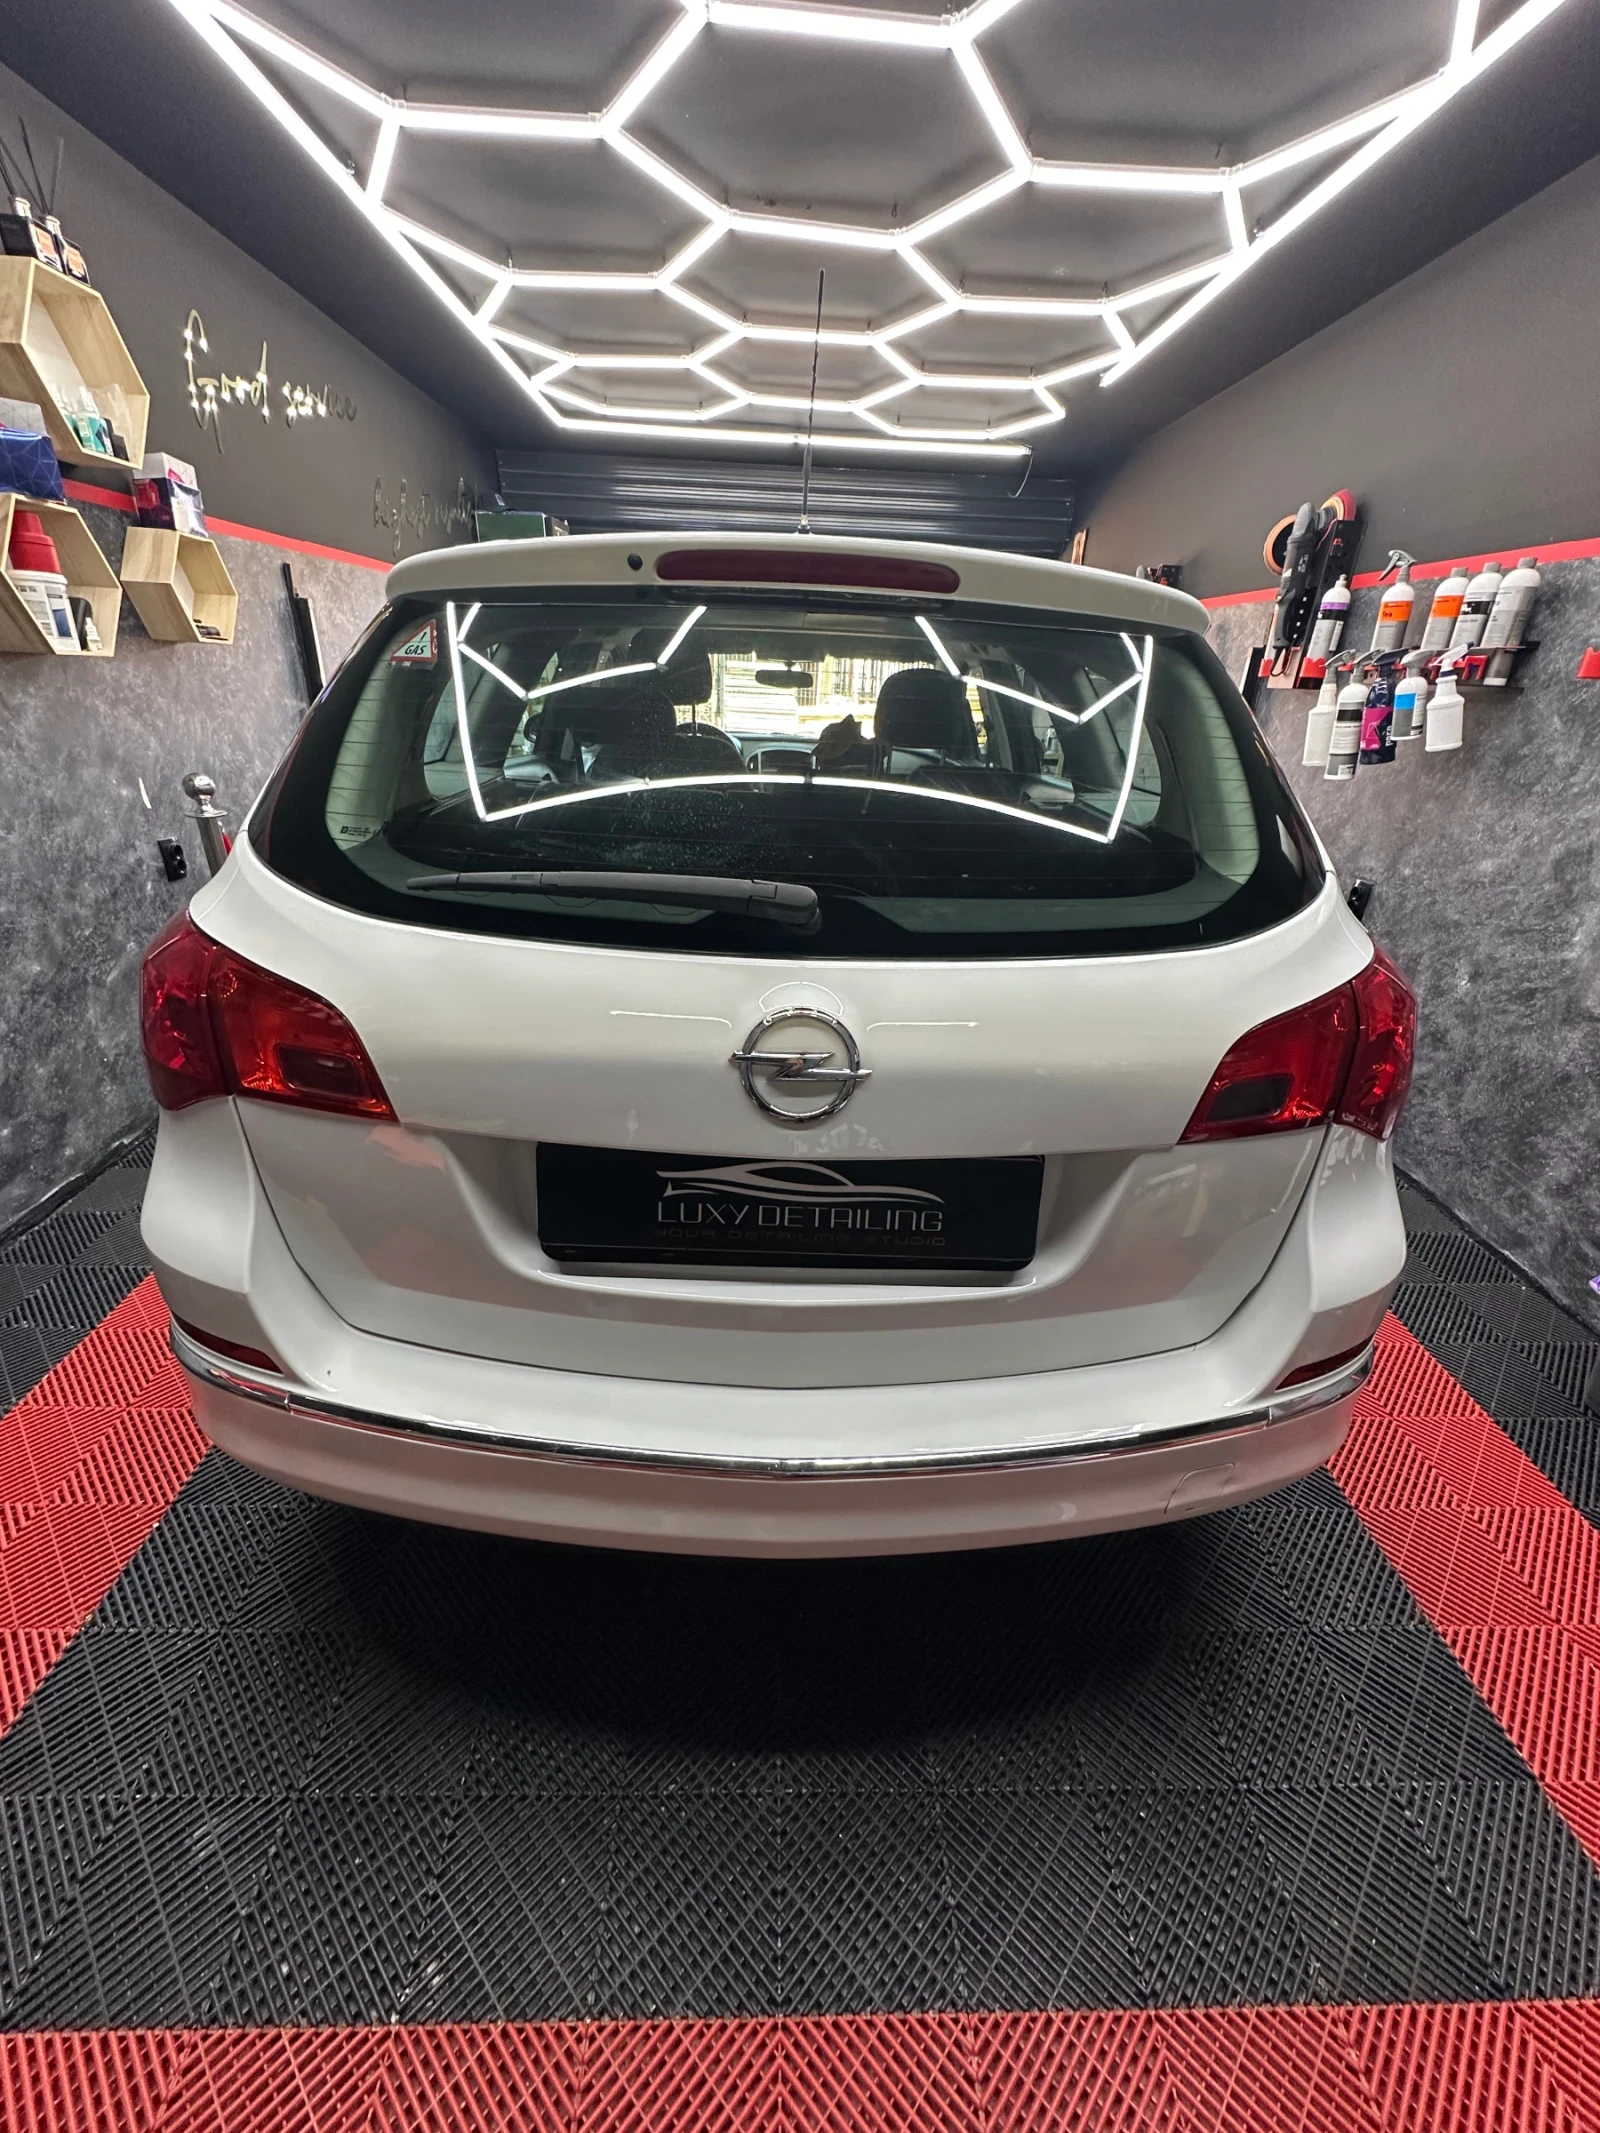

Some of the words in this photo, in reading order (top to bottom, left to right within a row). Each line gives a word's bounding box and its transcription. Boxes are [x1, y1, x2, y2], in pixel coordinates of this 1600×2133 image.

[404, 644, 427, 655] GAS
[657, 1201, 750, 1225] LUXY
[758, 1205, 943, 1232] DETAILING
[653, 1227, 716, 1239] YOUR
[728, 1230, 851, 1244] DETAILING
[863, 1235, 946, 1246] STUDIO
